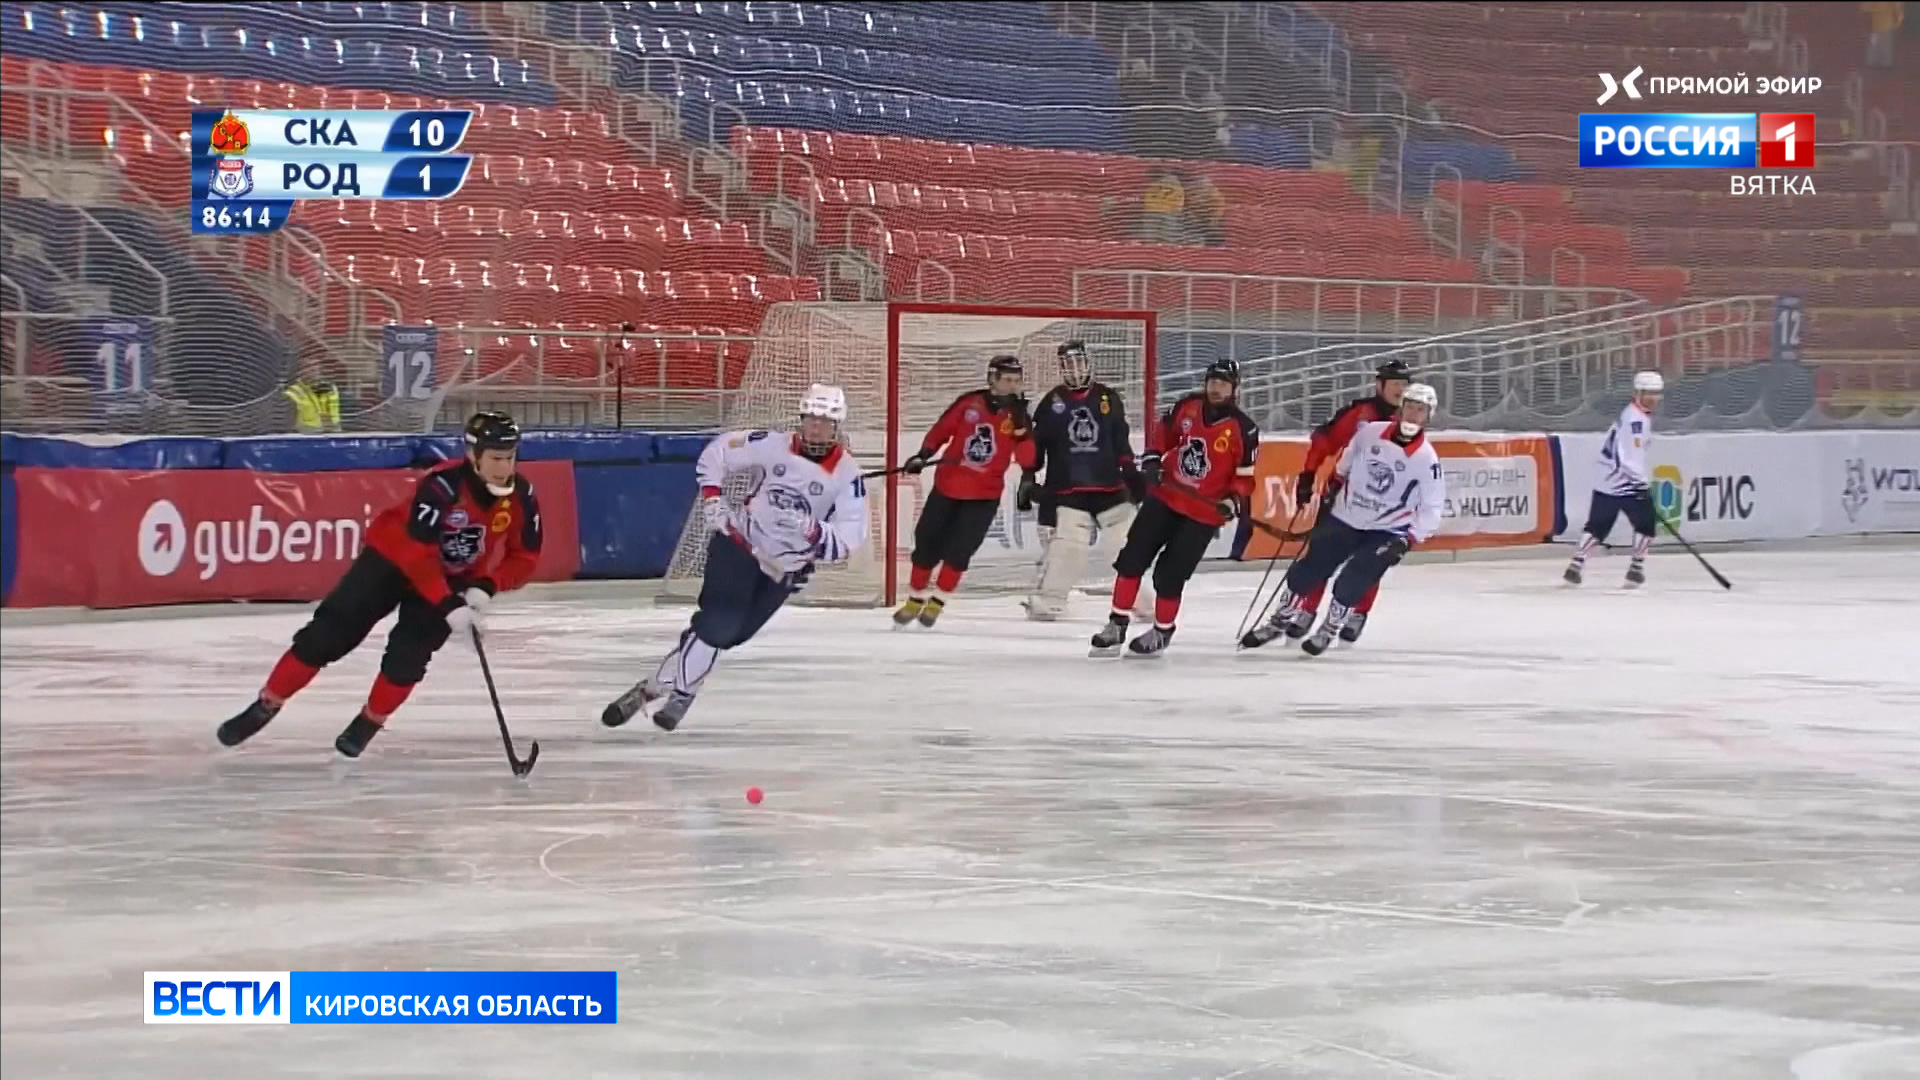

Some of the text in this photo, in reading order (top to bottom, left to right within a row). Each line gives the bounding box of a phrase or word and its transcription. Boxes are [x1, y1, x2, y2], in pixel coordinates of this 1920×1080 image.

[1777, 309, 1801, 346] 12
[97, 343, 142, 393] 11
[388, 351, 433, 398] 12
[417, 503, 440, 526] 71
[1687, 475, 1756, 522] 2ГИС
